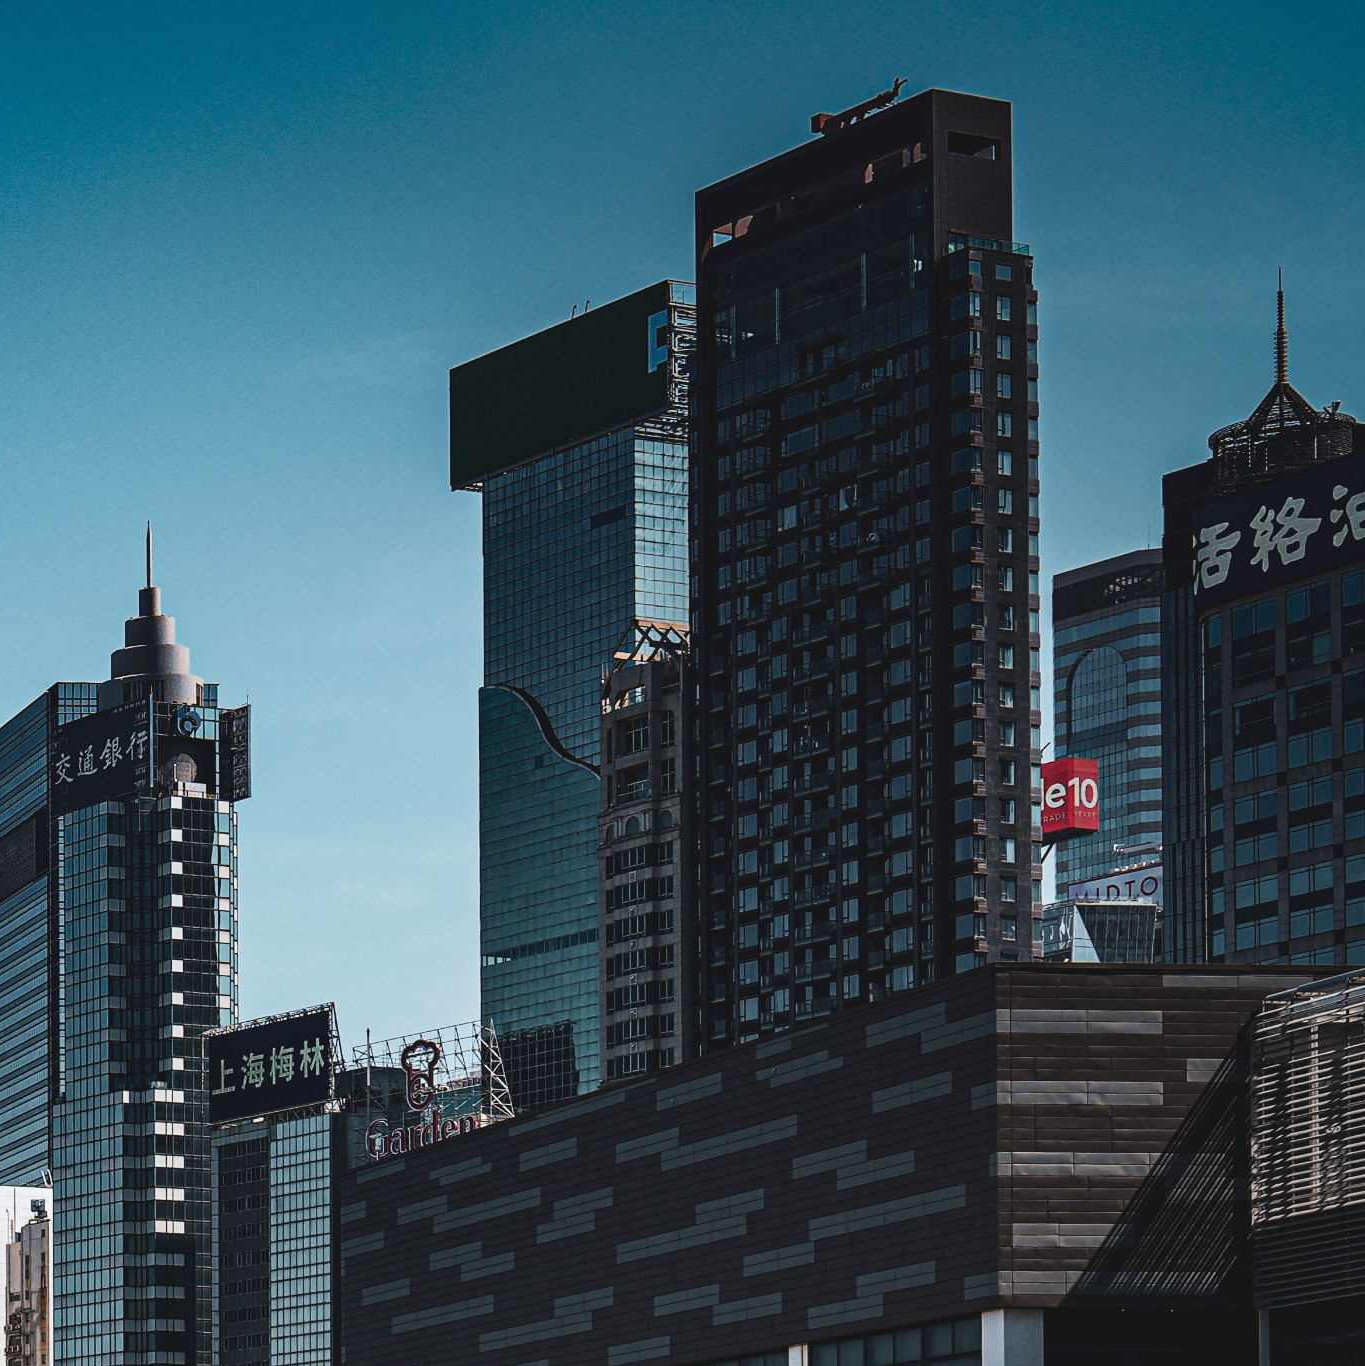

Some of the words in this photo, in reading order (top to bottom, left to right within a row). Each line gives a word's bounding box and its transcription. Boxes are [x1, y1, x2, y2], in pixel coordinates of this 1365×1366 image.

[55, 730, 148, 785] 交通銀行
[1042, 812, 1067, 823] RADE
[1074, 876, 1159, 900] IDTO
[212, 1038, 325, 1096] 上海梅林
[365, 1109, 478, 1160] Garden
